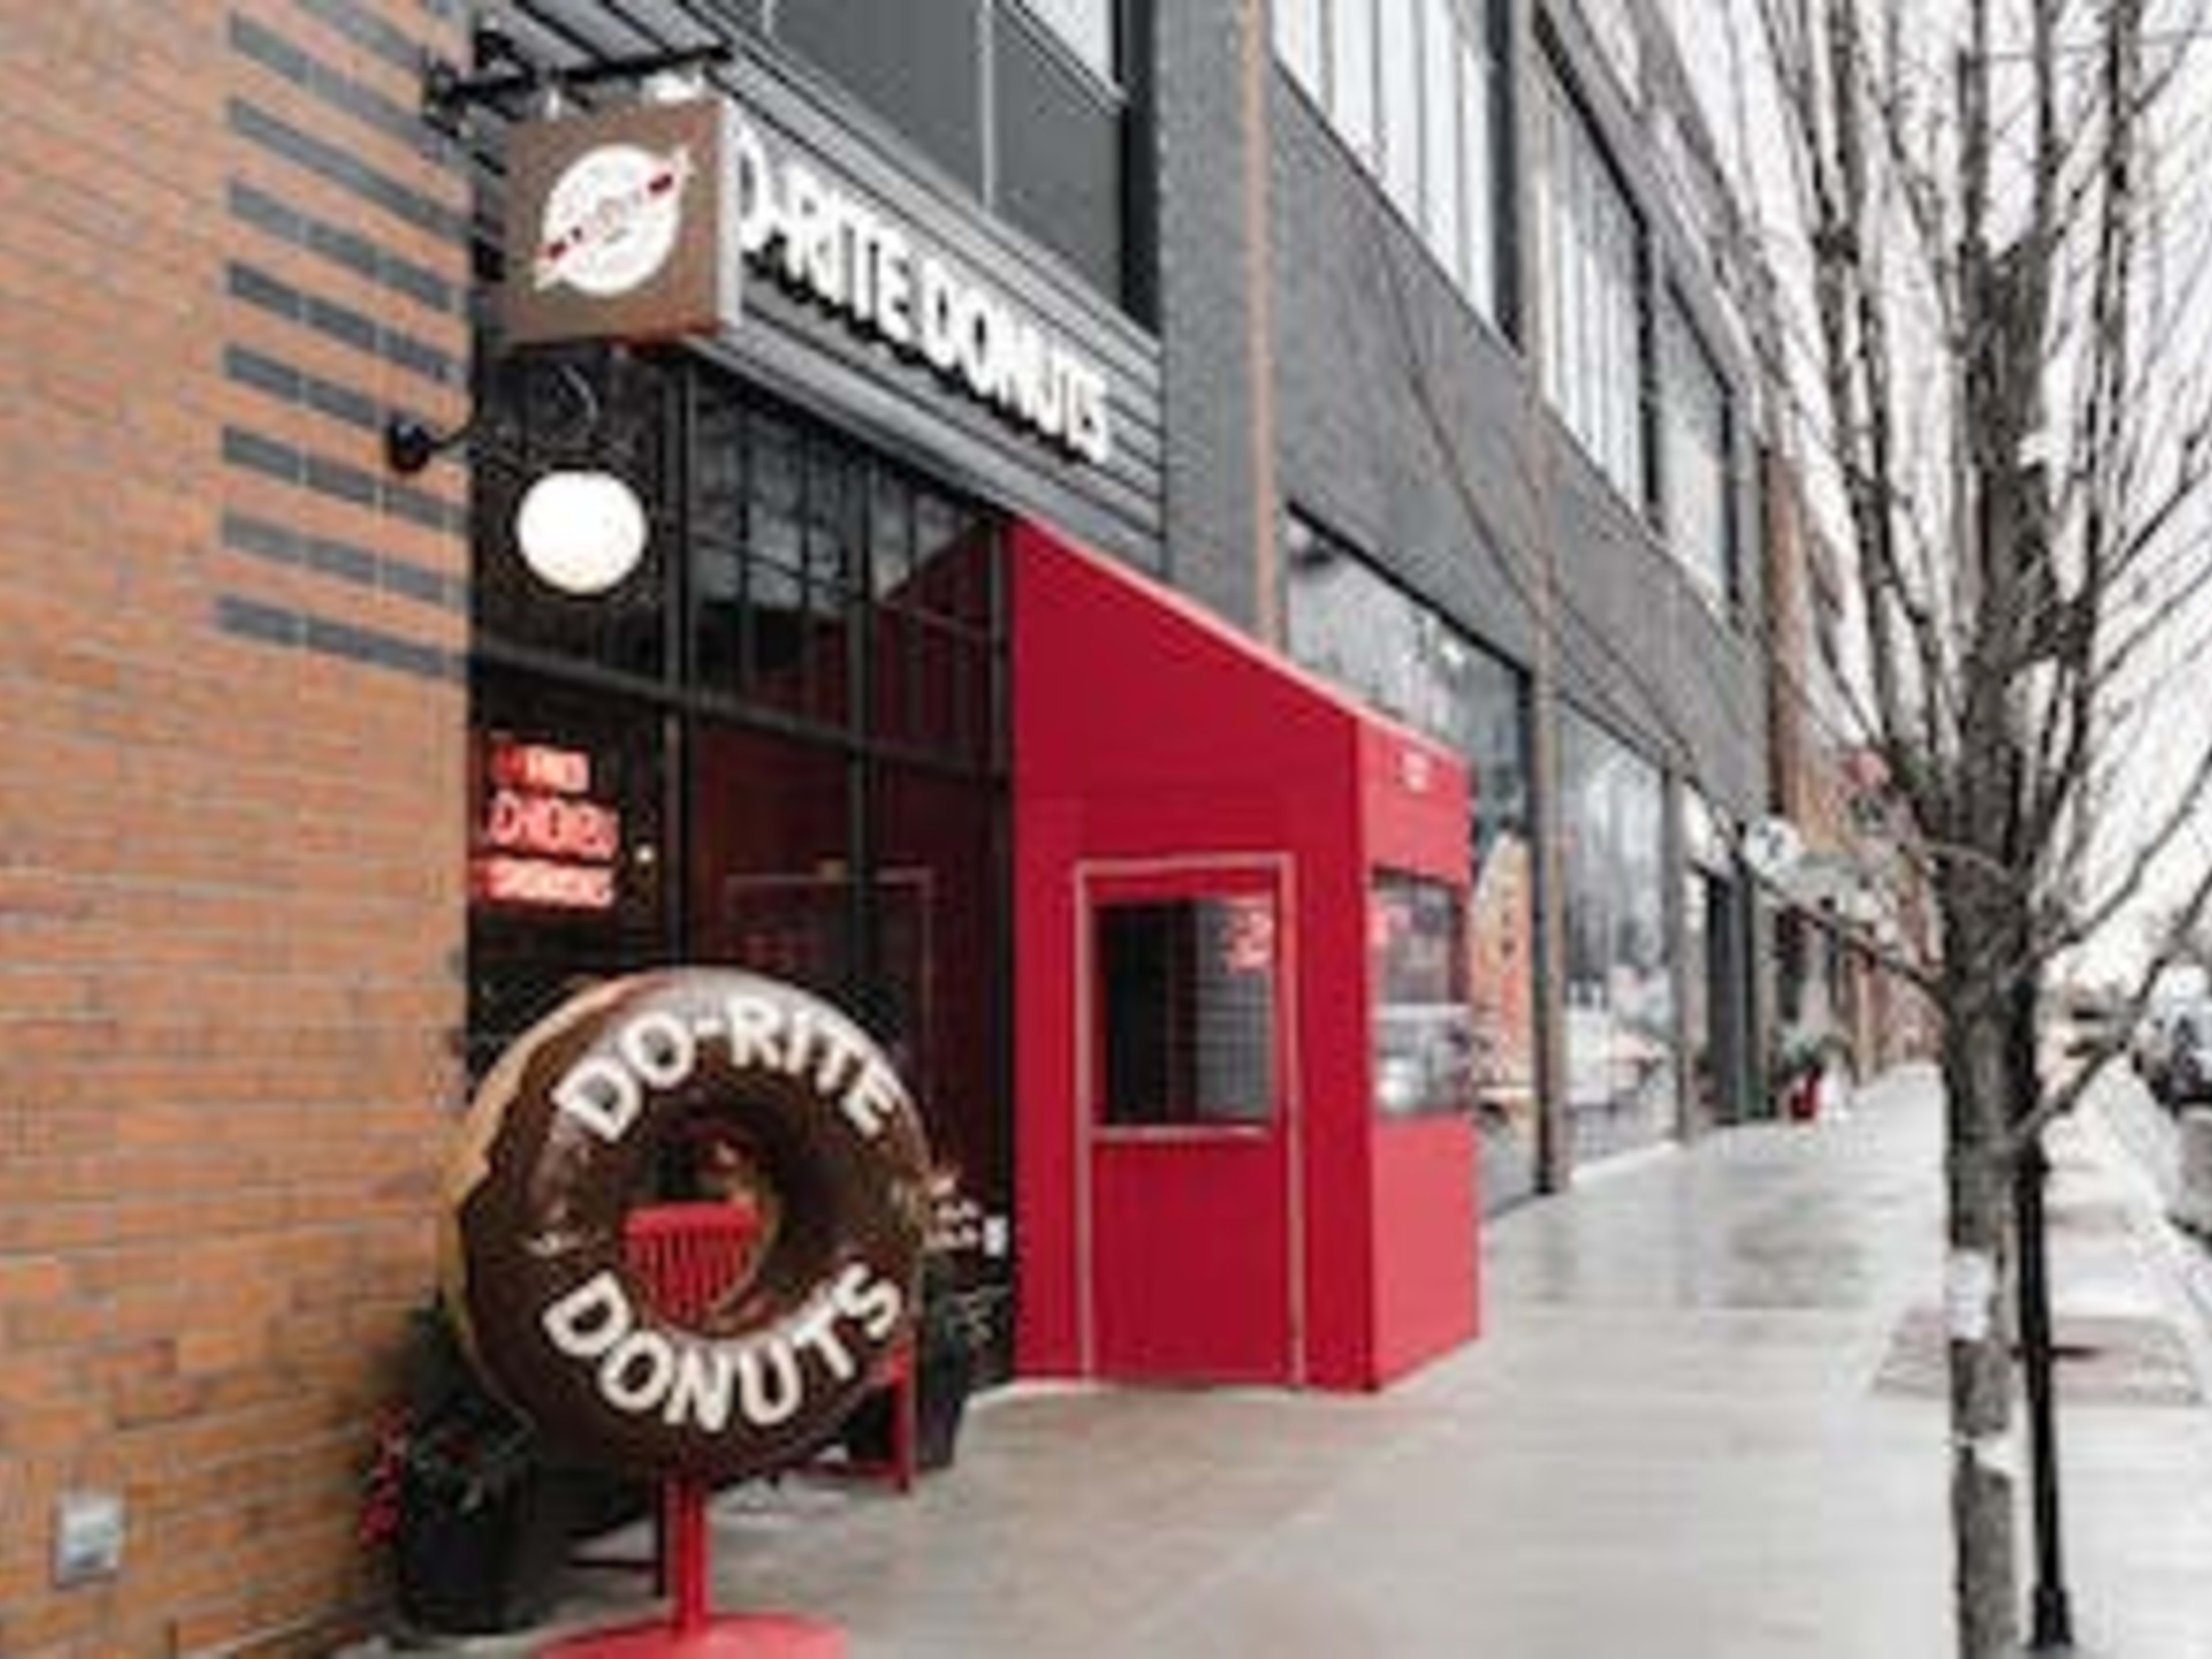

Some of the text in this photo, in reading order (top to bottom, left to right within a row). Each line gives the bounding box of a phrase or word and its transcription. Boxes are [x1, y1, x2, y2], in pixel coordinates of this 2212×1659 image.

[923, 258, 1108, 462] DONUTS
[551, 996, 901, 1142] DO-RITE
[542, 1263, 902, 1432] DONUTS
